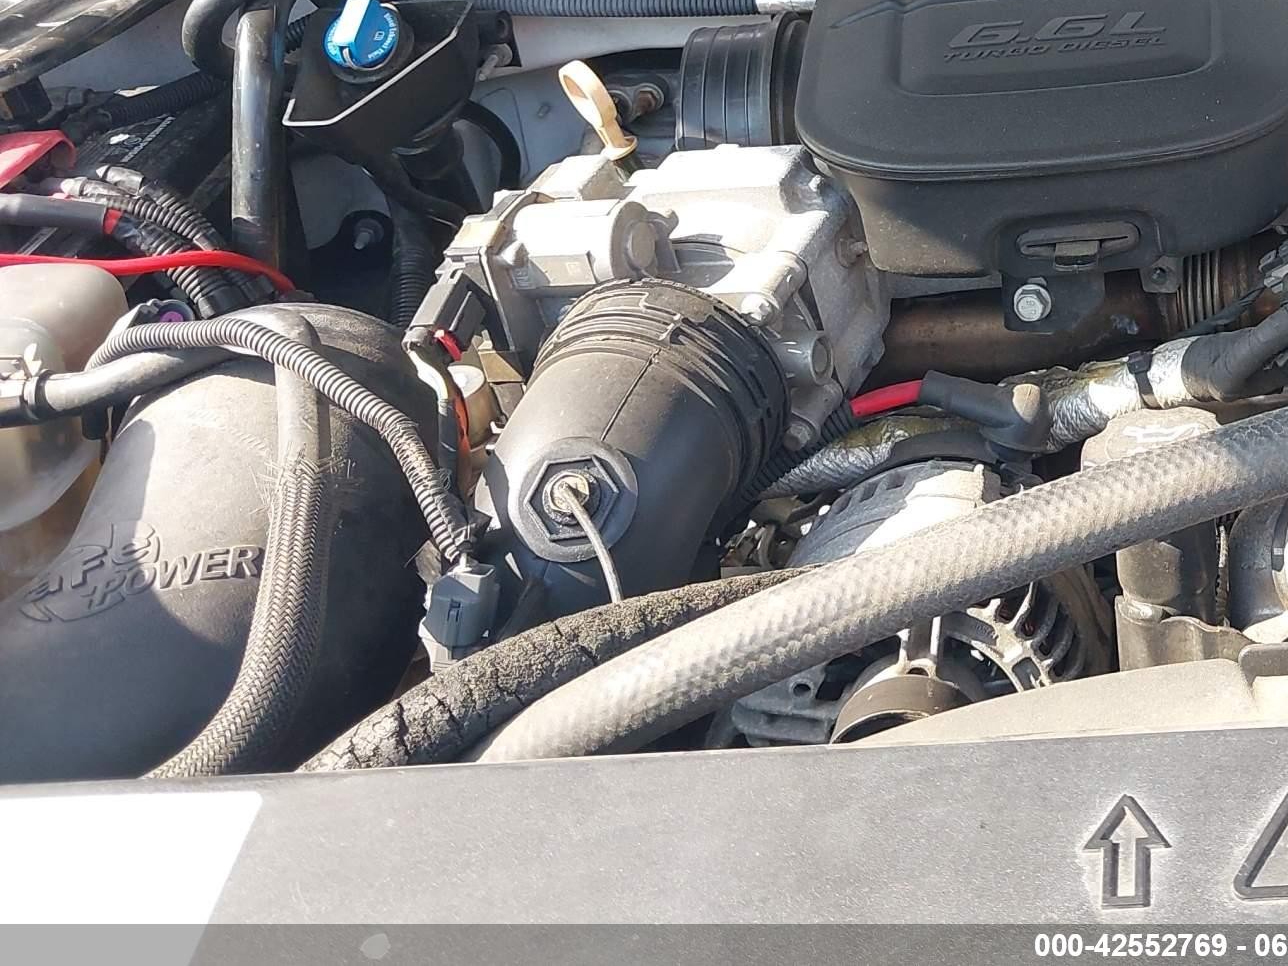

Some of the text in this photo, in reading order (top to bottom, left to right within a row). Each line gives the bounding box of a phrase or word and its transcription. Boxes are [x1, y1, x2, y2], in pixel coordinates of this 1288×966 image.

[943, 34, 1169, 63] TURBO DIESEL
[950, 11, 1167, 49] 6.6L
[84, 545, 266, 611] POWER
